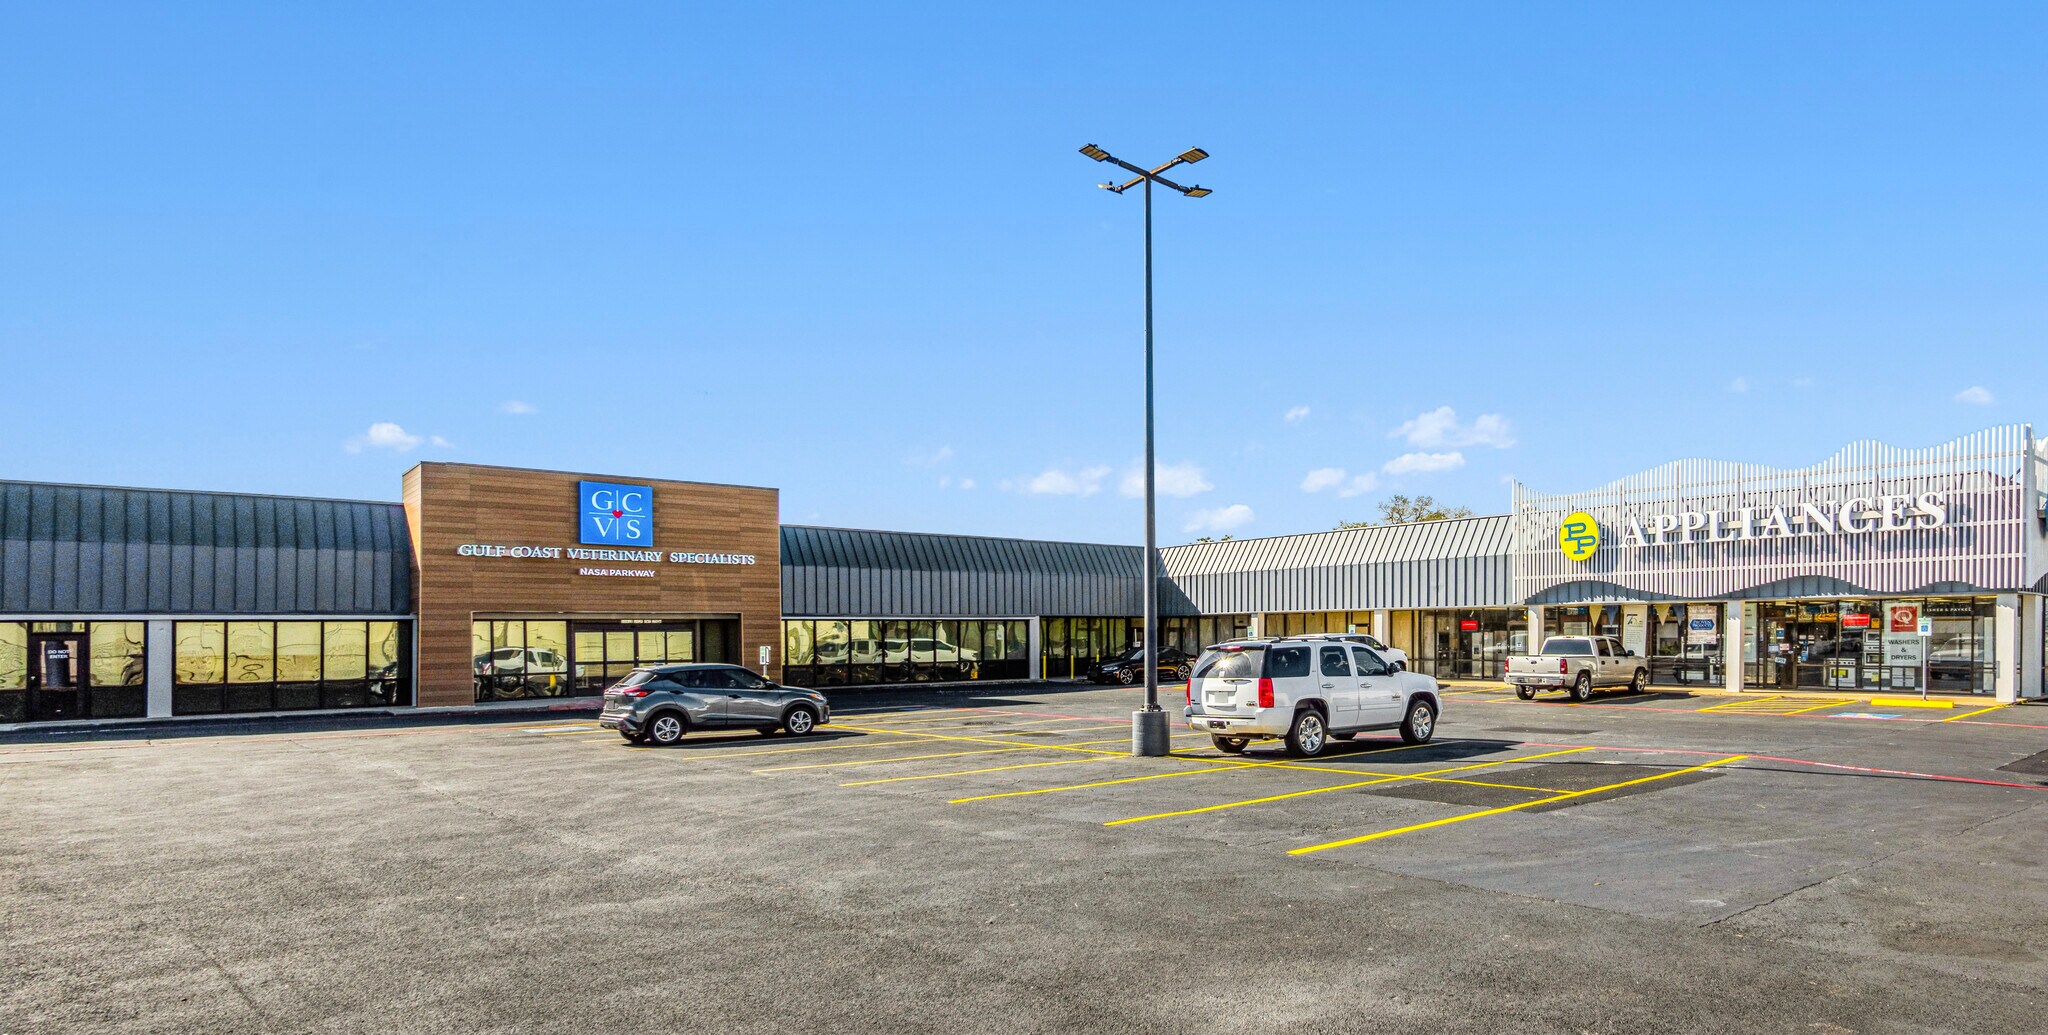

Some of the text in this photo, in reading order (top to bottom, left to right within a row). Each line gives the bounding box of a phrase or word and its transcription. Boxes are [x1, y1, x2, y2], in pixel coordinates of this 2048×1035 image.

[1618, 490, 1947, 549] APPLIANCES
[458, 544, 755, 565] GULF COAST VETERINARY SPECIALISTS
[580, 567, 655, 578] NASA PARKWAY
